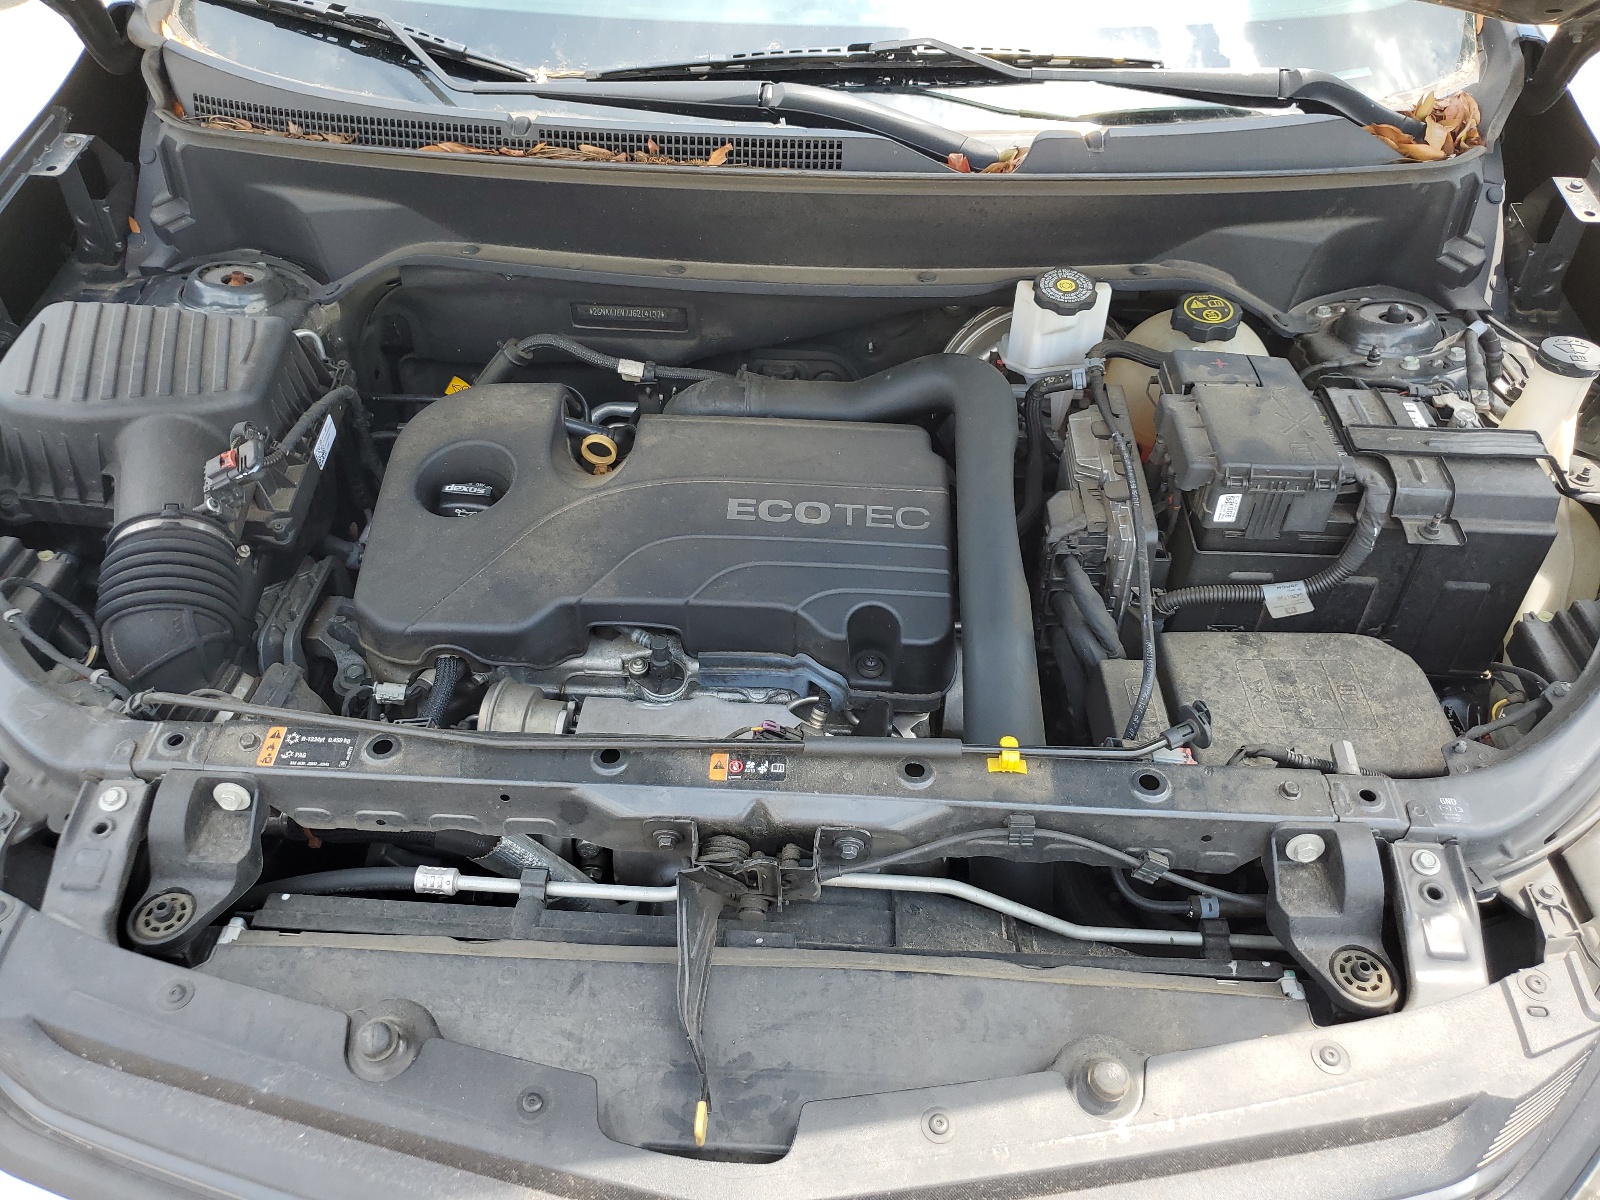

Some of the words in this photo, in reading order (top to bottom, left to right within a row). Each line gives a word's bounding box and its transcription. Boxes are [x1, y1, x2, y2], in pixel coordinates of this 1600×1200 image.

[444, 484, 486, 494] dexos
[727, 498, 930, 530] ECOTEC
[1439, 797, 1457, 805] GND
